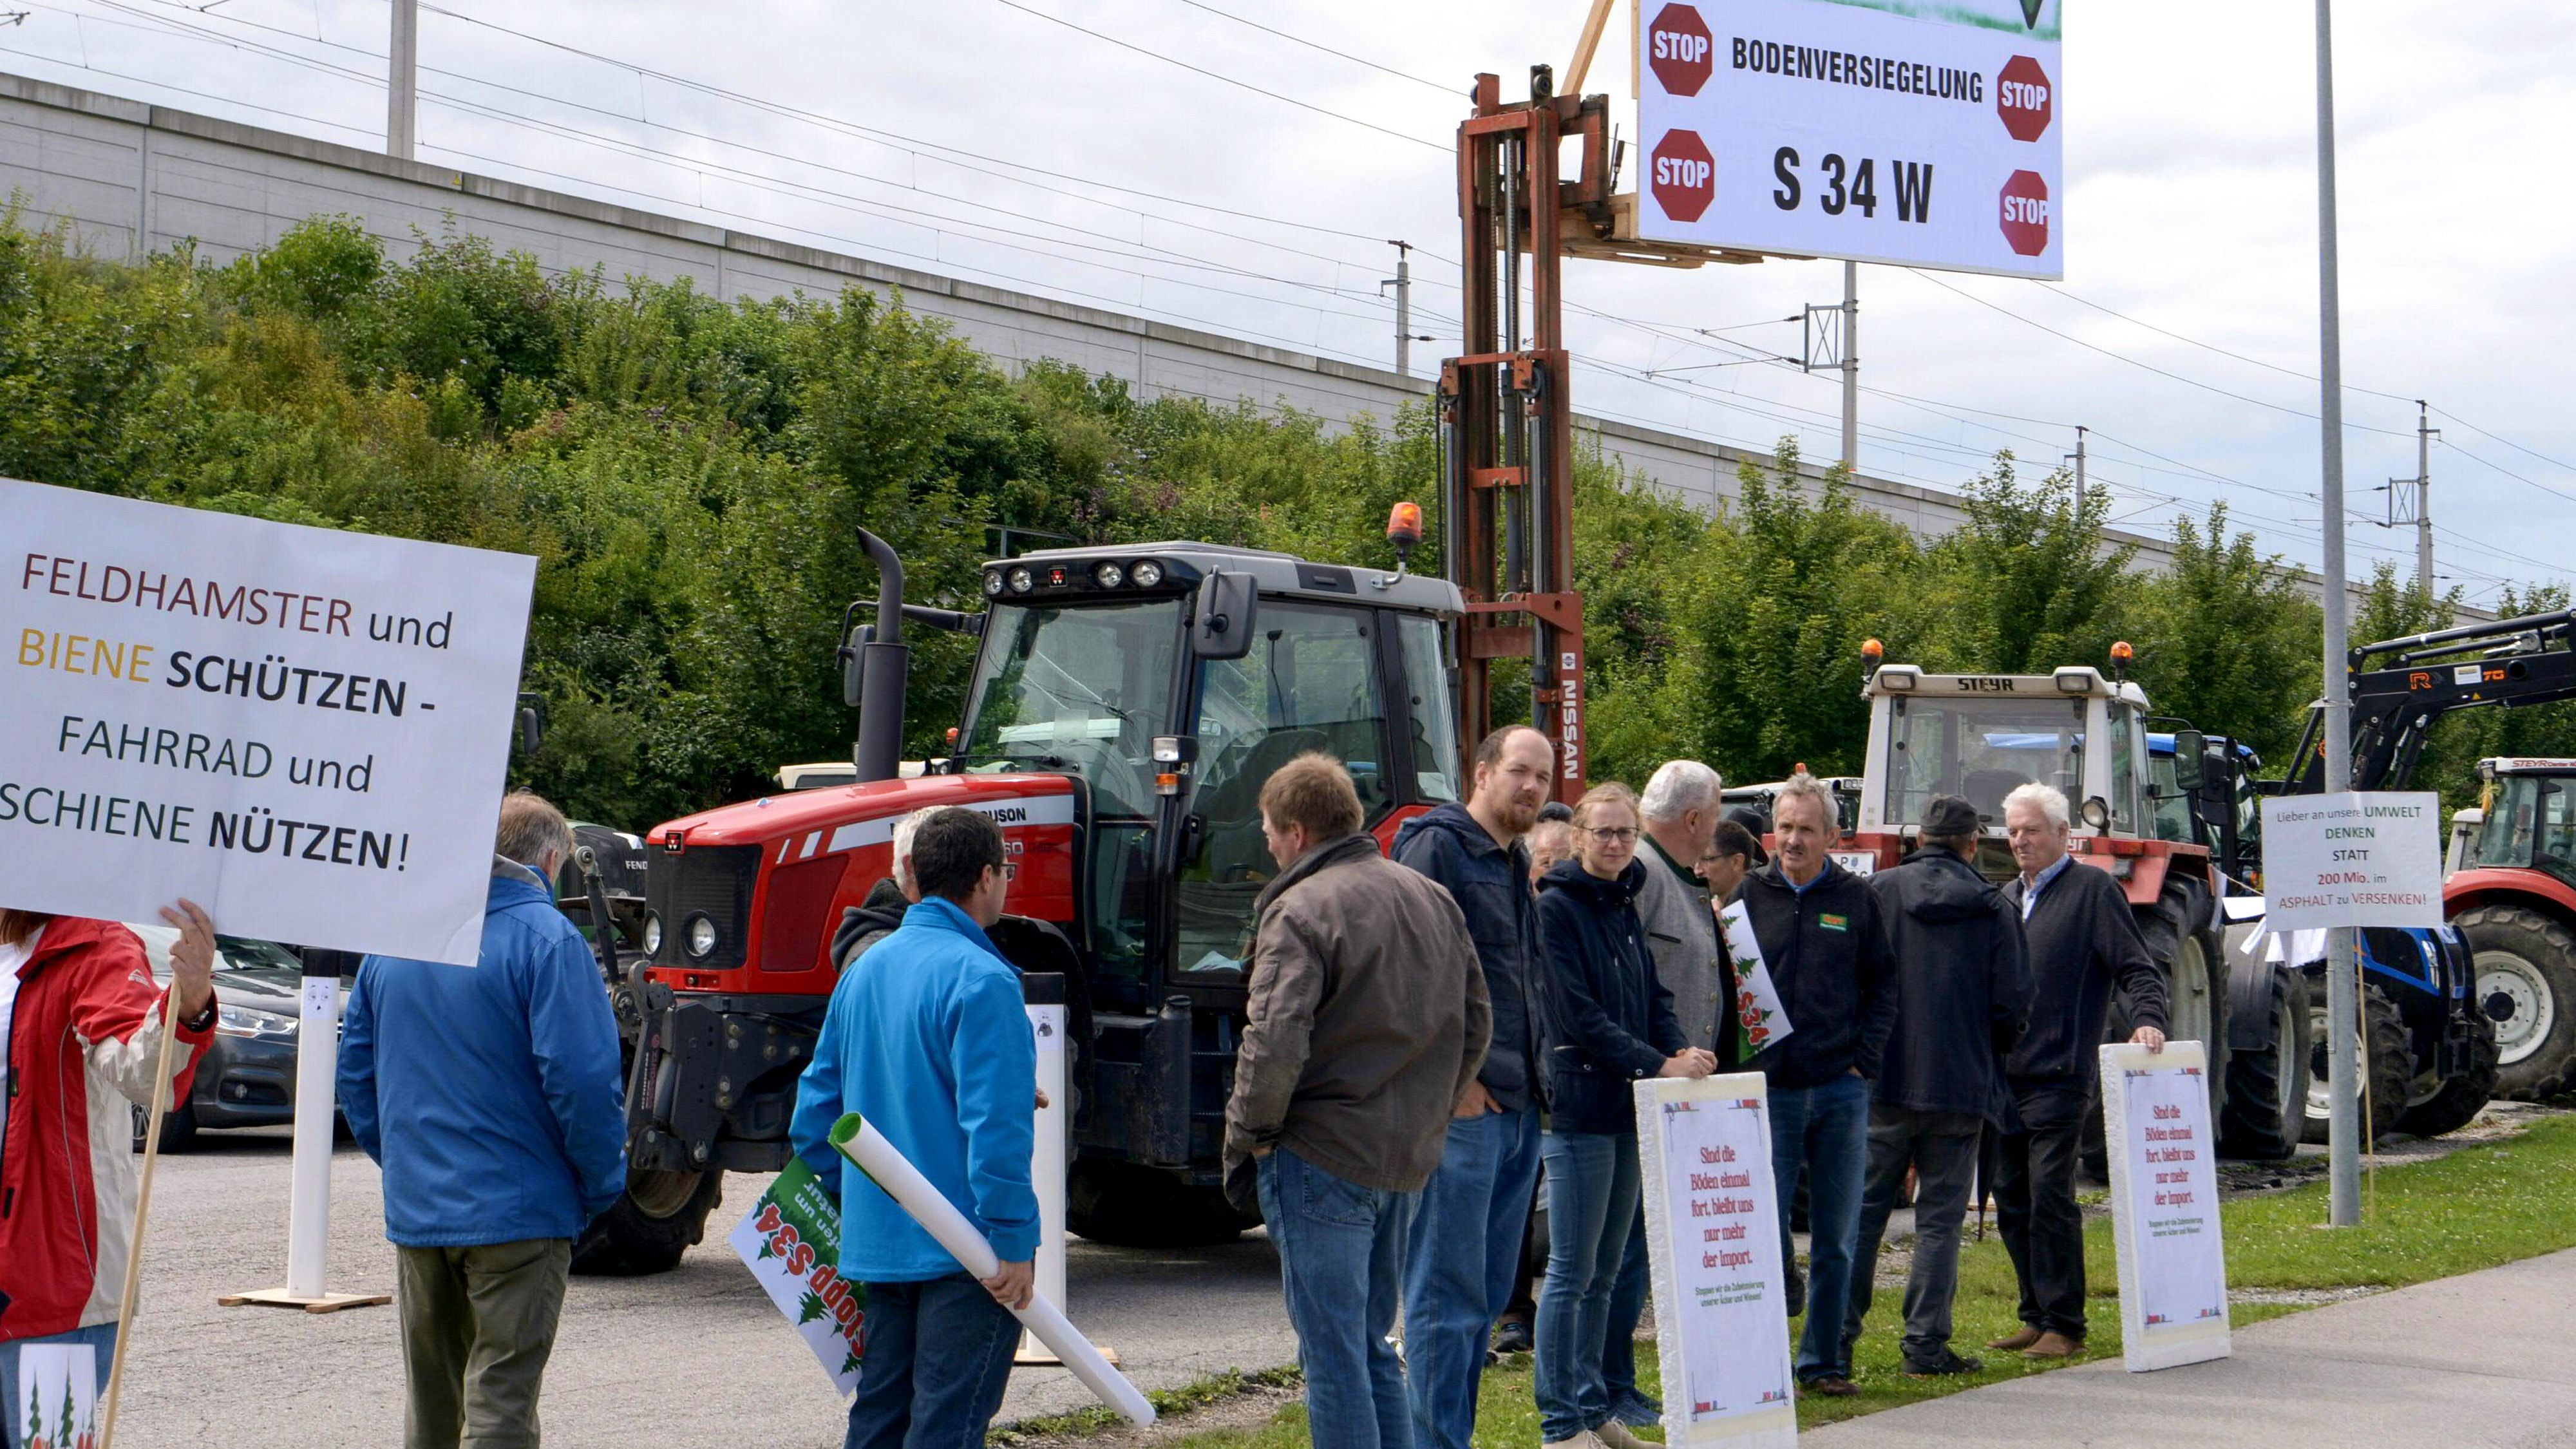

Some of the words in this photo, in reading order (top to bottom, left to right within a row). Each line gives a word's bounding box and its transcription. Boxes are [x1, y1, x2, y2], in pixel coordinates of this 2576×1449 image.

[1654, 30, 1708, 64] STOP
[1732, 37, 1983, 103] BODENVERSIEGELUNG
[2002, 80, 2047, 111] STOP
[1656, 156, 1710, 189] STOP
[1773, 146, 1801, 211] S
[1820, 153, 1877, 218] 34
[1893, 159, 1933, 224] W
[2004, 195, 2048, 225] STOP
[22, 553, 352, 637] FELDHAMSTER
[368, 611, 453, 649] und
[17, 628, 155, 683] BIENE
[166, 651, 407, 717] SCHÜTZEN
[1958, 677, 2014, 691] STEYR
[1562, 680, 1578, 779] NISSAN
[58, 715, 272, 779] FAHRRAD
[289, 754, 374, 793] und
[981, 807, 1027, 822] USON
[2277, 810, 2309, 822] Lieber
[2312, 811, 2324, 820] an
[2327, 810, 2360, 819] unsere
[2364, 806, 2421, 818] UMWELT
[0, 783, 194, 844] SCHIENE
[208, 806, 410, 872] NÜTZEN!
[2325, 828, 2375, 839] DENKEN
[2333, 849, 2369, 861] STATT
[2318, 873, 2340, 885] 200
[2344, 871, 2371, 884] Mio.
[2374, 873, 2387, 883] im
[2278, 894, 2333, 909] ASPHALT
[2337, 896, 2349, 905] zu
[2351, 893, 2427, 905] VERSENKEN!
[1700, 1146, 1721, 1164] Sind
[1722, 1145, 1736, 1162] die
[1690, 1172, 1719, 1191] Böden
[1721, 1170, 1750, 1188] einmal
[1691, 1198, 1711, 1217] fort,
[1712, 1197, 1736, 1215] bleibt
[1738, 1198, 1754, 1213] uns
[755, 1202, 815, 1276] S34
[1704, 1228, 1720, 1242] nur
[1723, 1222, 1746, 1240] mehr
[1703, 1251, 1718, 1268] der
[1719, 1249, 1753, 1271] Import.
